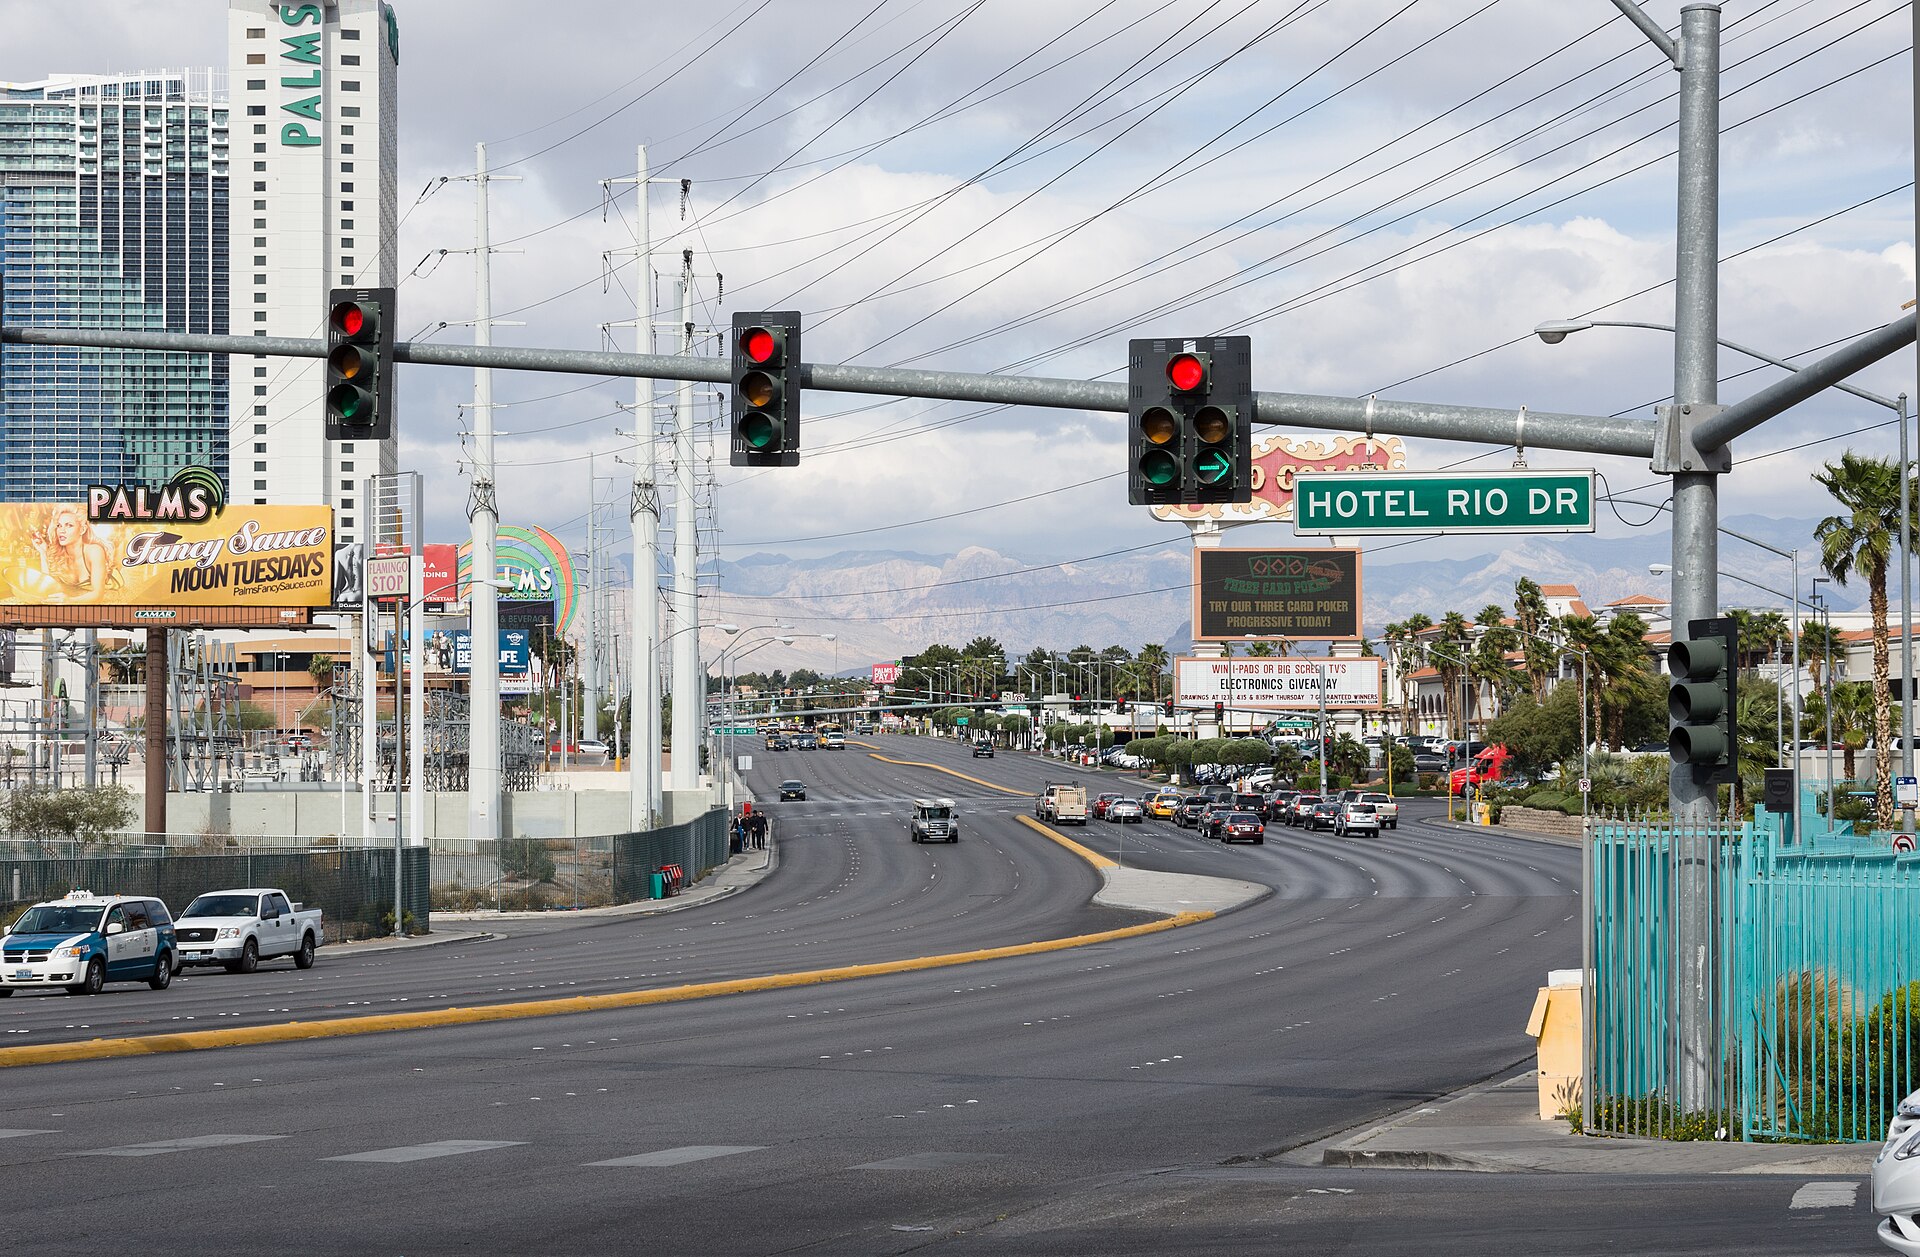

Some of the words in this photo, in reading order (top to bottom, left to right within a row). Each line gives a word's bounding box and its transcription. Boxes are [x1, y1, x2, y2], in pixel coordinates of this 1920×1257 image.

[280, 4, 321, 146] PALMS
[89, 486, 208, 520] PALMS
[1309, 490, 1429, 518] HOTEL
[1448, 488, 1508, 516] RIO
[1528, 487, 1578, 516] DR
[122, 531, 225, 569] Fancy
[228, 520, 326, 555] Sauce
[170, 562, 228, 594] MOON
[232, 551, 324, 586] TUESDAYS
[368, 560, 408, 574] FLAMINGO
[233, 578, 324, 596] PalmsFancySauce.com
[372, 575, 404, 592] STOP
[1224, 578, 1260, 595] THREE
[1262, 582, 1291, 595] CARD
[1294, 578, 1330, 594] POKER
[1209, 601, 1228, 612] TRY
[1231, 601, 1251, 612] OUR
[1254, 601, 1284, 612] THREE
[1287, 601, 1314, 612] CARD
[1317, 600, 1348, 612] POKER
[508, 614, 549, 622] BEVERAGE
[1226, 616, 1292, 628] PROGRESSIVE
[1296, 616, 1330, 628] TODAY!
[1212, 665, 1228, 674] WIN
[1233, 665, 1259, 674] I-PADS
[1264, 664, 1274, 674] OR
[1278, 664, 1290, 674] BIG
[1295, 664, 1320, 674] SCREE
[1329, 664, 1346, 673] TV'S
[1220, 679, 1282, 690] ELECTRONICS
